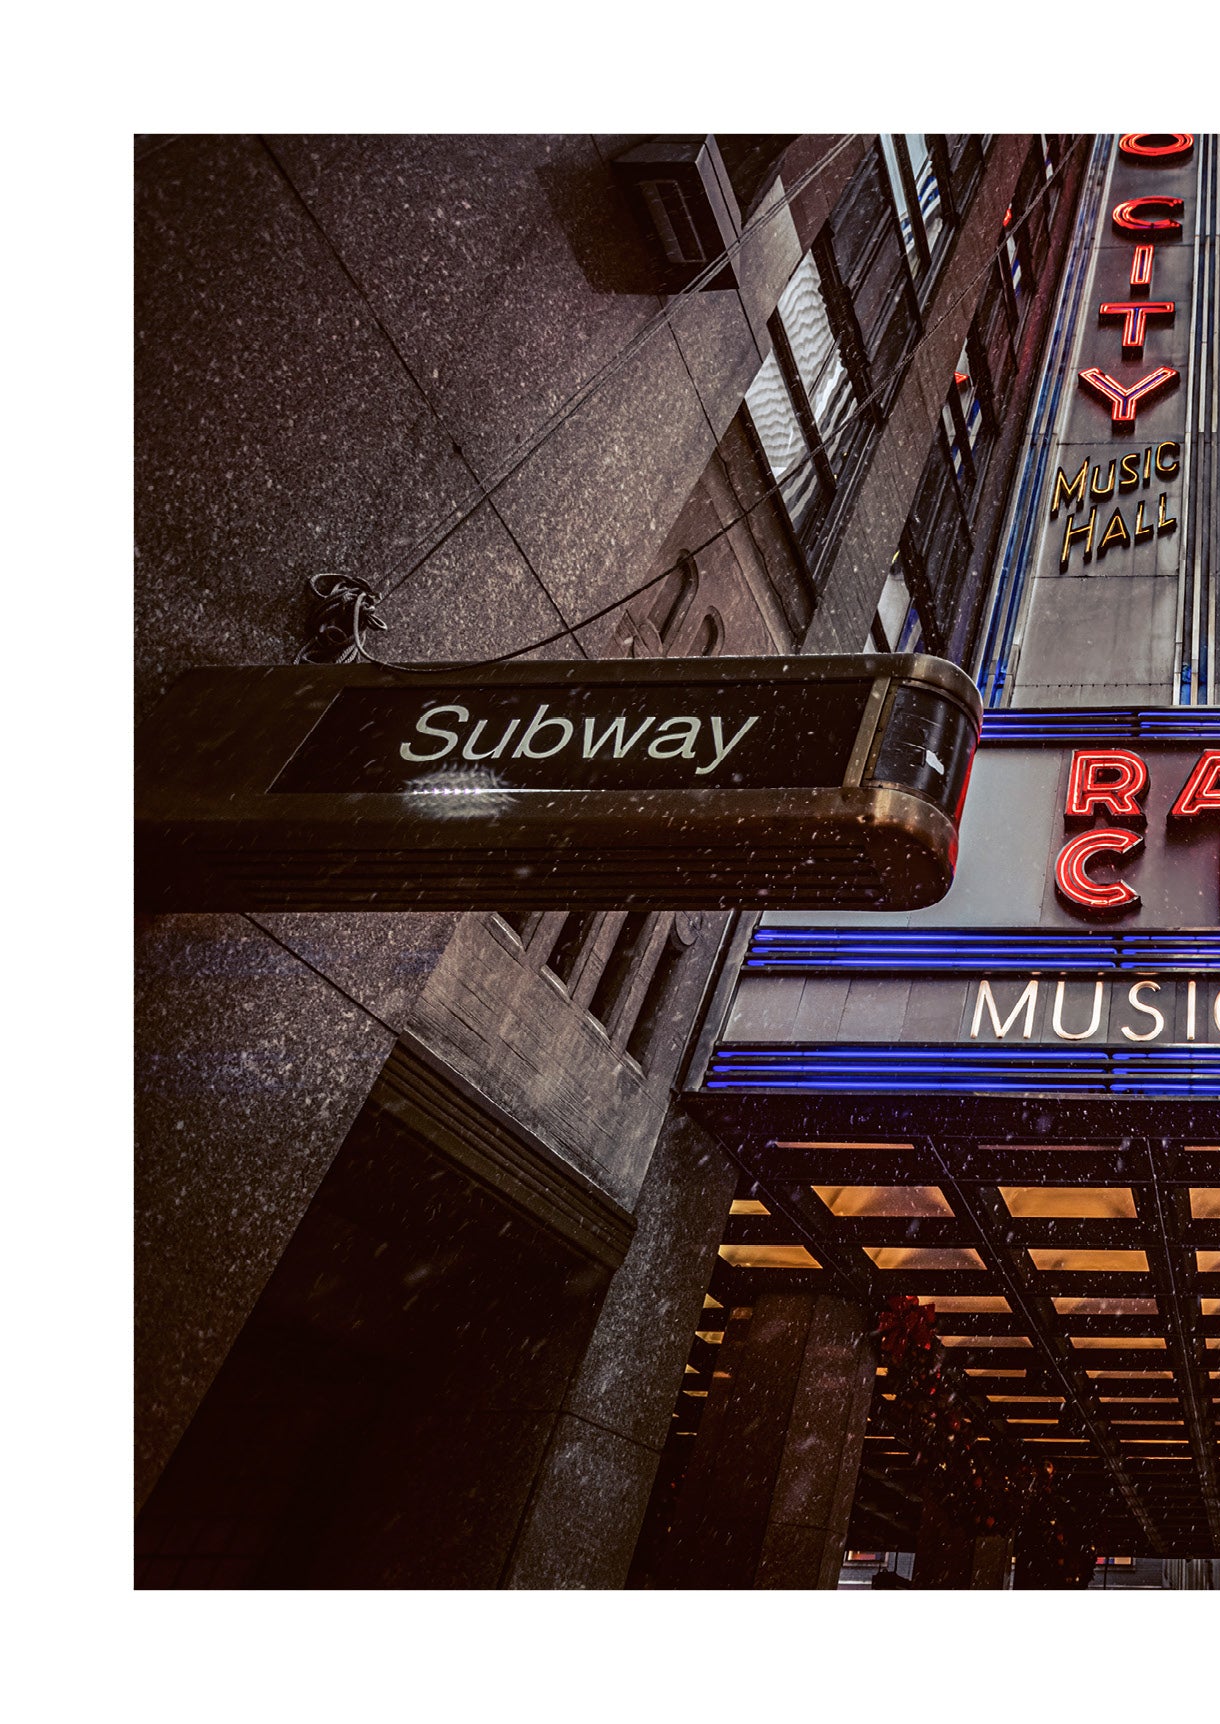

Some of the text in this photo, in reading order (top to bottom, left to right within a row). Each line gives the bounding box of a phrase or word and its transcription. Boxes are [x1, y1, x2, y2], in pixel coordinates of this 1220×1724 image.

[1078, 196, 1184, 431] CITY
[1051, 441, 1180, 517] MUSIC
[1060, 493, 1176, 573] HALL
[400, 704, 759, 774] Subway
